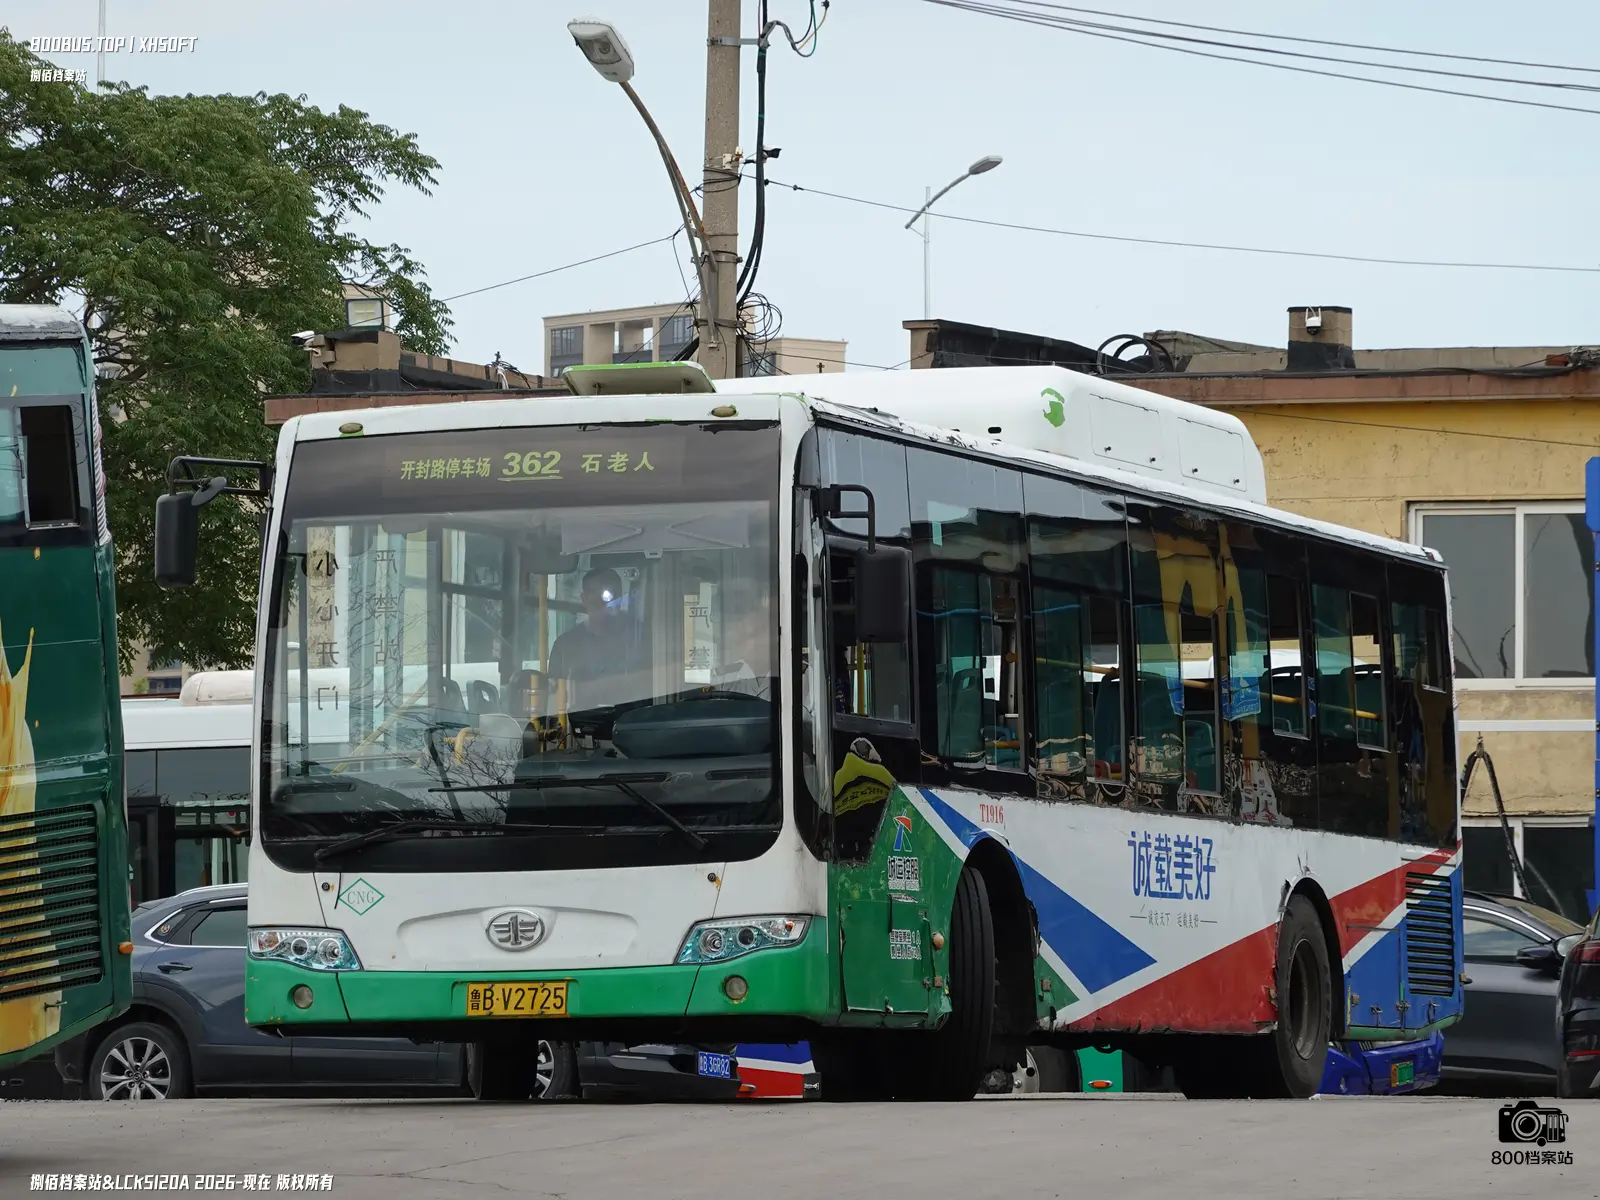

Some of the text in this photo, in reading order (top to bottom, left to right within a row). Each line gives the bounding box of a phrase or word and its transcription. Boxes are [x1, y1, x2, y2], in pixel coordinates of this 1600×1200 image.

[400, 450, 655, 480] 开封路停车场 362 石老人
[980, 803, 1004, 824] T1916
[1127, 830, 1217, 901] 诚载美好
[346, 890, 375, 905] CNG
[469, 985, 565, 1012] 鲁B·V2725
